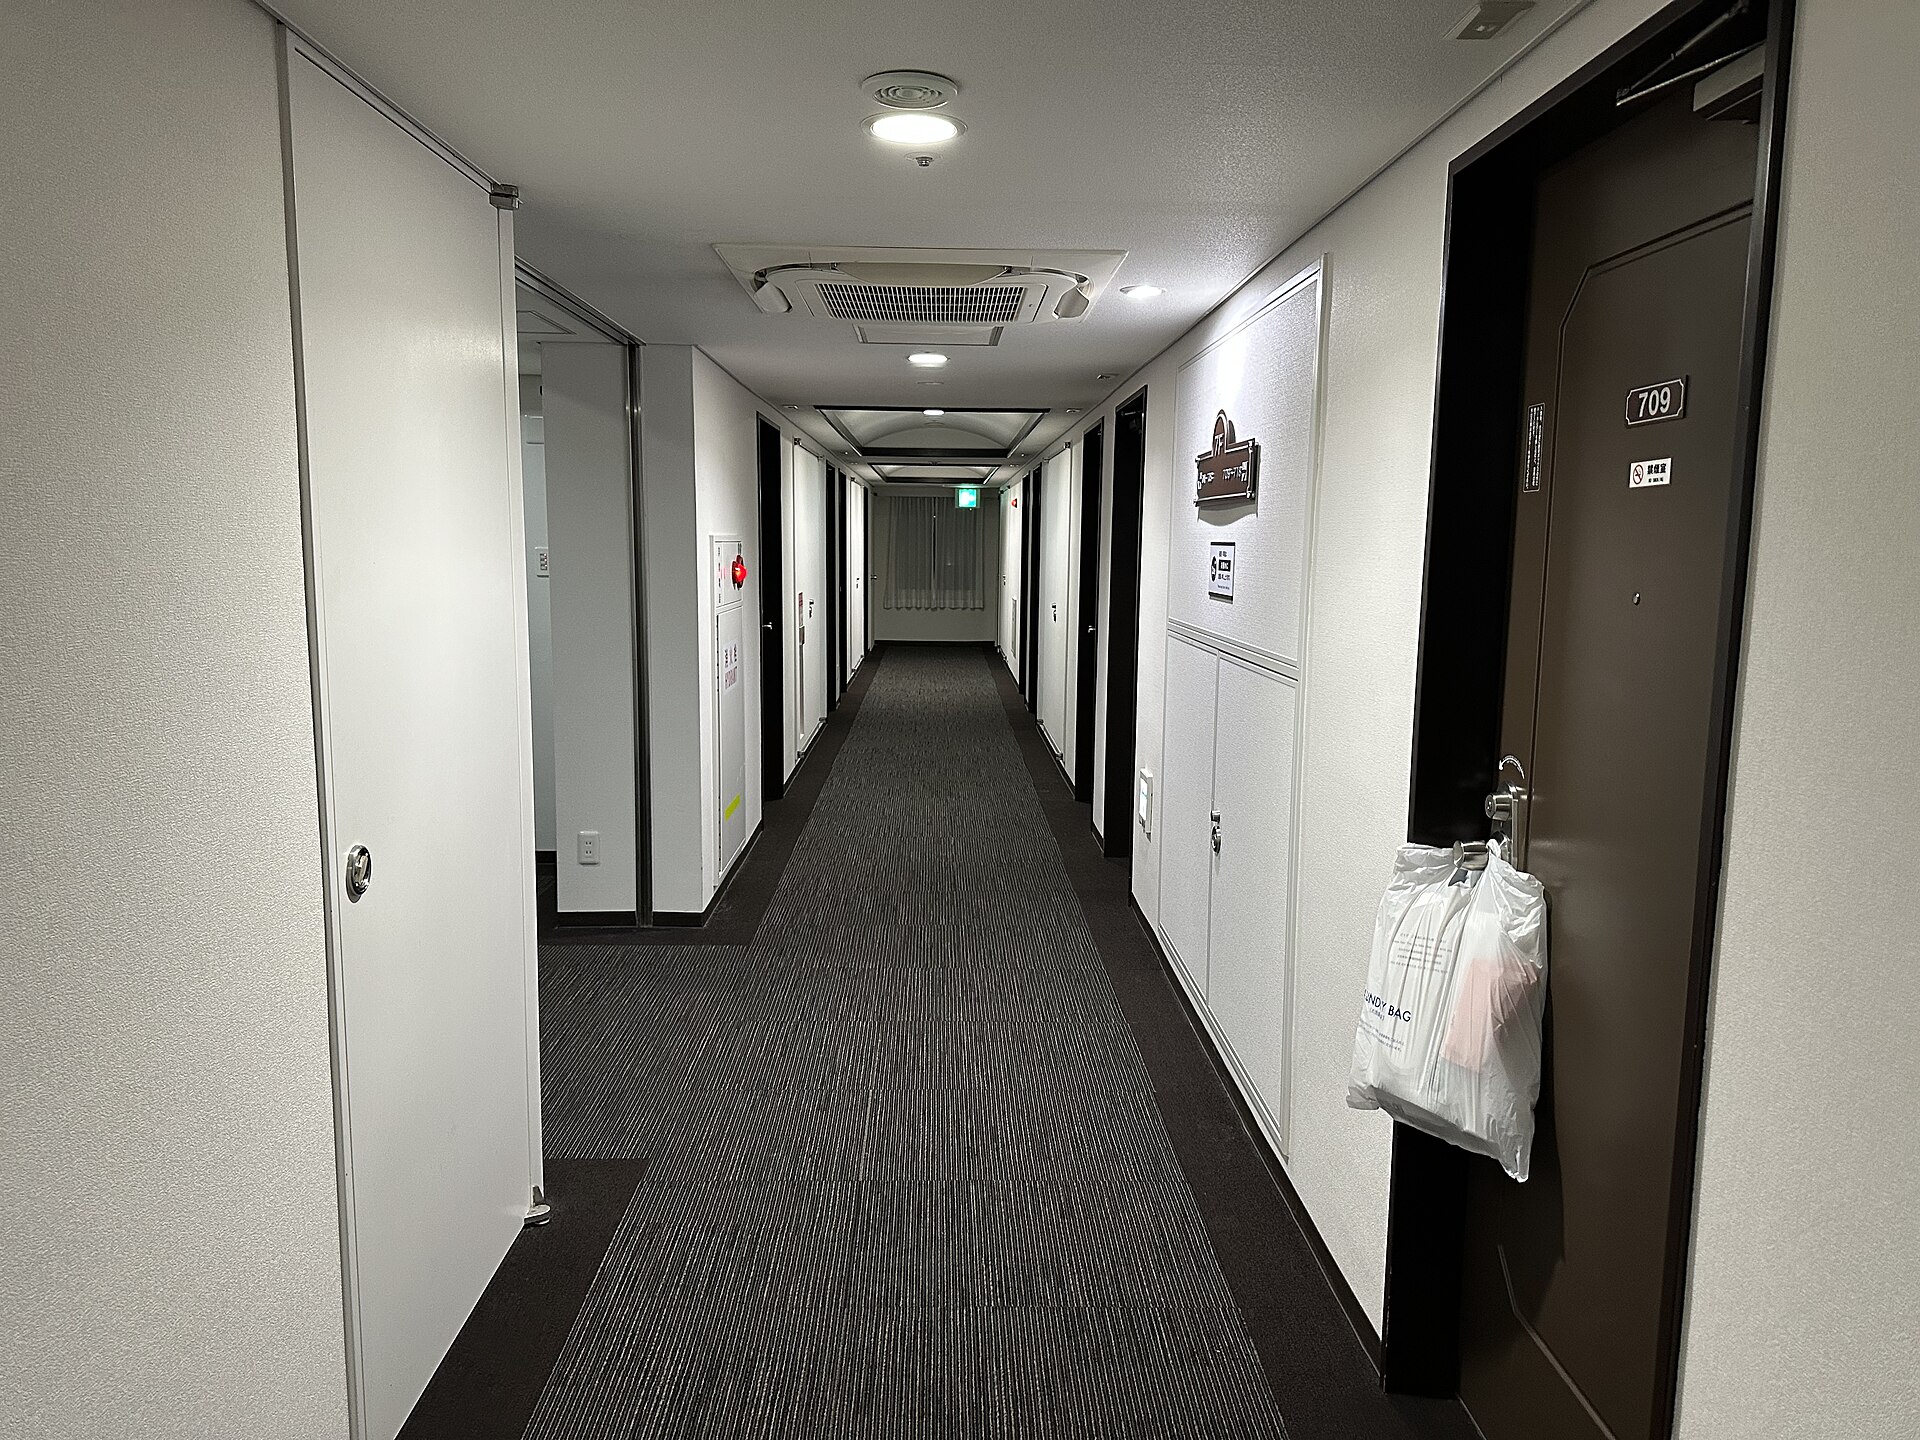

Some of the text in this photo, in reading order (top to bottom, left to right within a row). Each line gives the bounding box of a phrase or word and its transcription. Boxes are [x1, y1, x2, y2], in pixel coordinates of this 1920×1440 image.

[1638, 386, 1671, 418] 709
[1214, 433, 1224, 456] 7F
[1388, 1005, 1412, 1023] BAG
